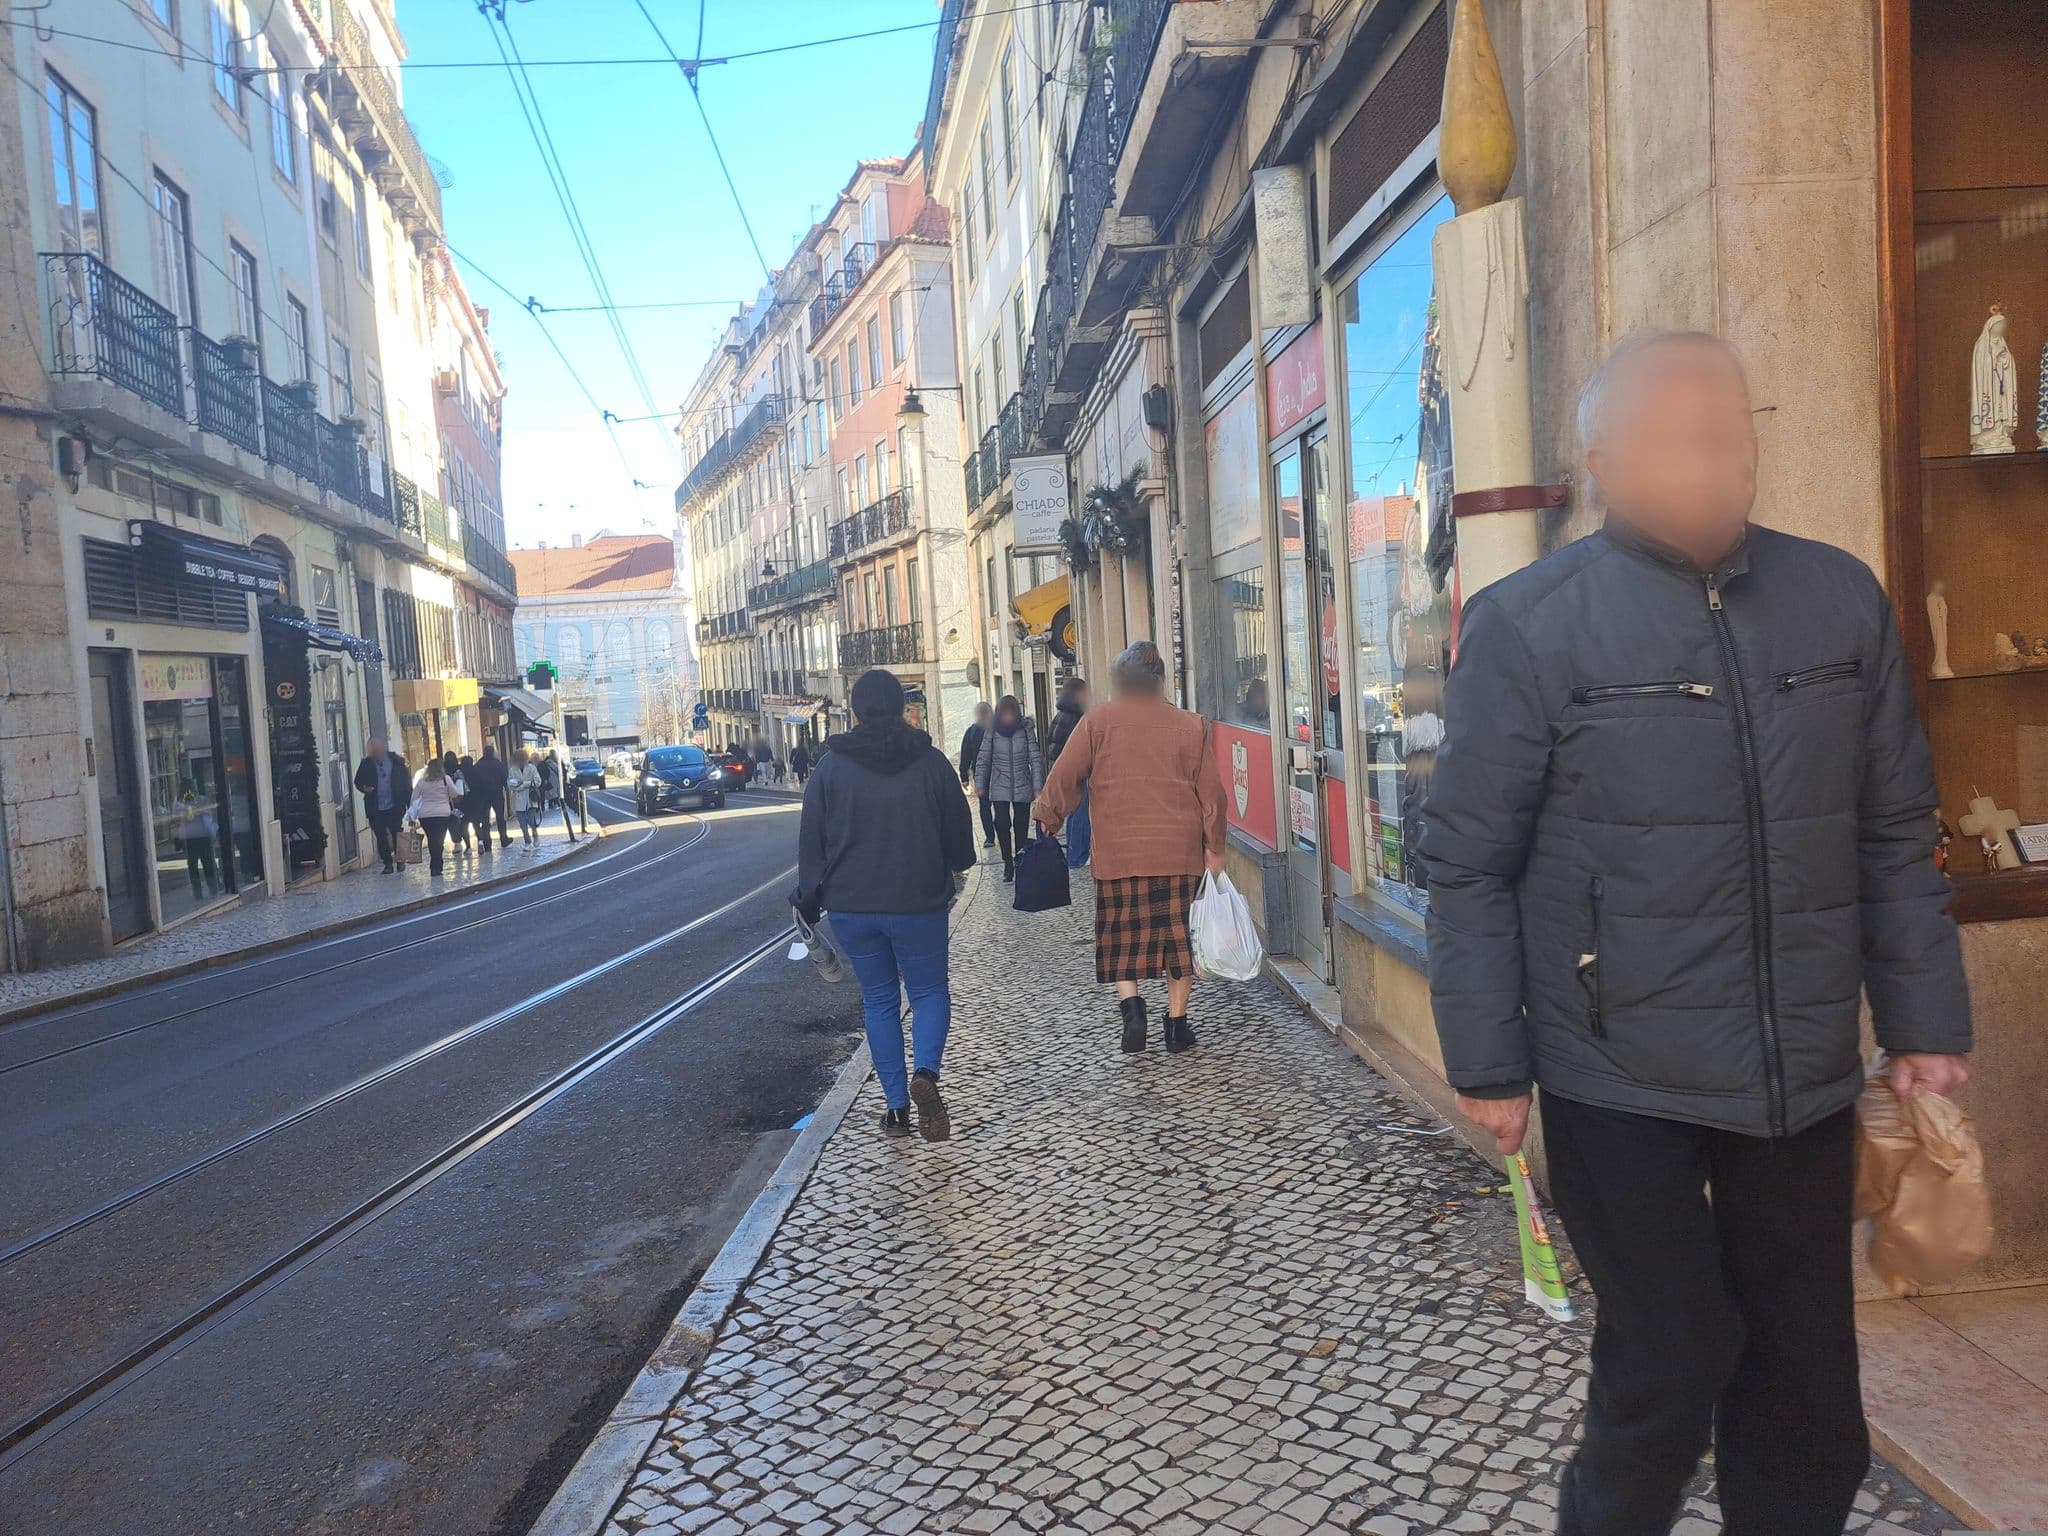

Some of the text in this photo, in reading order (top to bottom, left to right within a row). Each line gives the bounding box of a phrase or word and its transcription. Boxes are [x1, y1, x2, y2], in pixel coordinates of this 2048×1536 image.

[1016, 497, 1066, 511] CHIADO
[1026, 534, 1056, 543] pastelari
[205, 565, 215, 578] TEA
[217, 568, 235, 582] COFFEE
[279, 716, 298, 728] CAT
